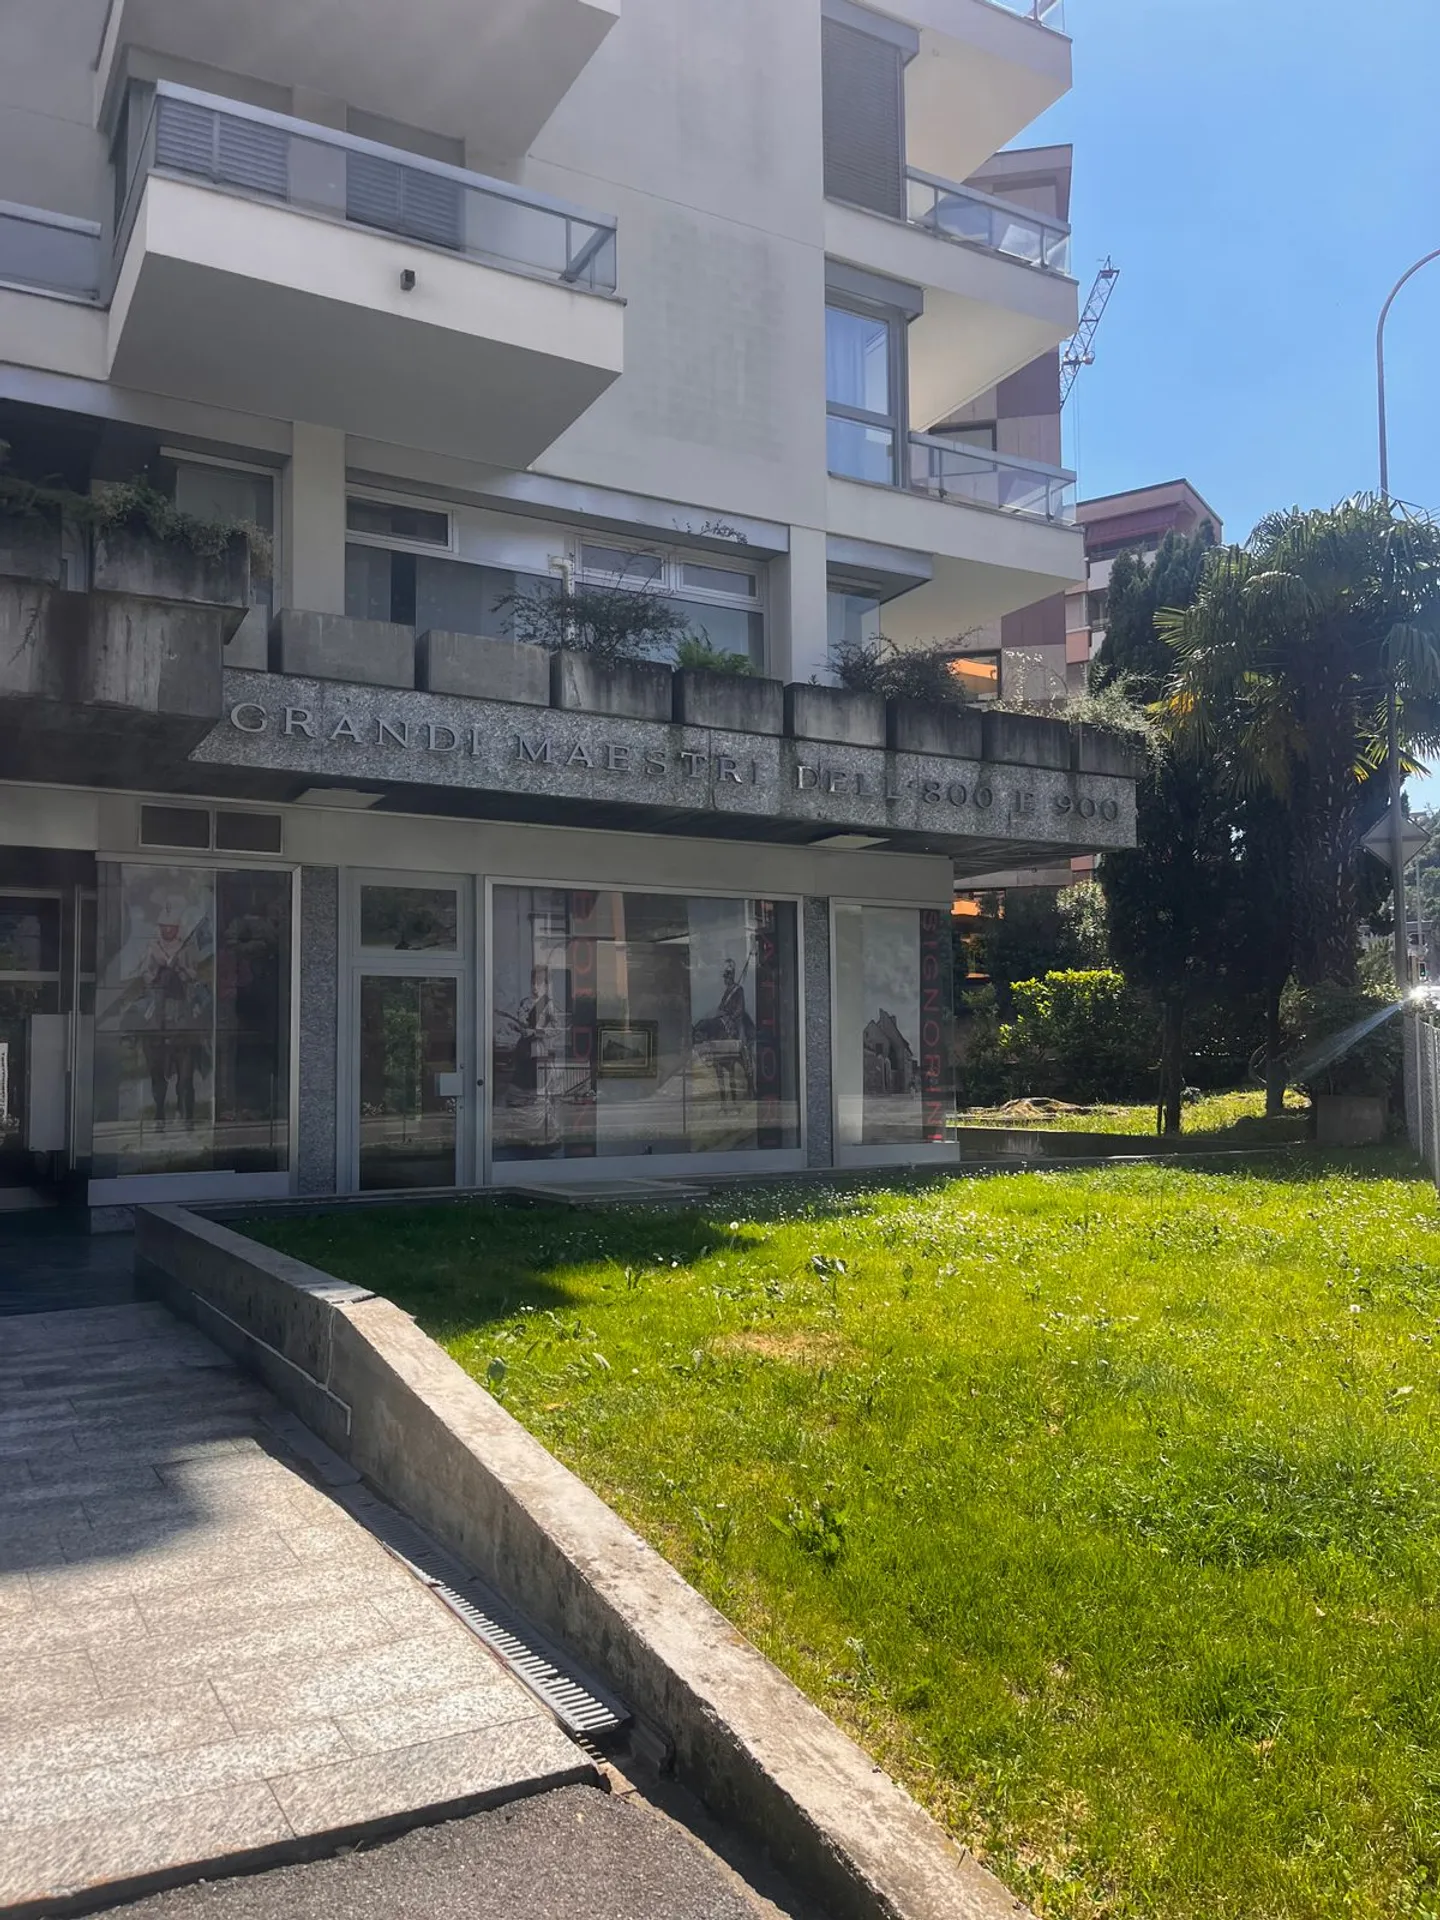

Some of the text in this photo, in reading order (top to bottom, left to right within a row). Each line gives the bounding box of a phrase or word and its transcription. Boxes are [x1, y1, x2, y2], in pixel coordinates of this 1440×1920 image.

[230, 702, 486, 757] GRANDI
[515, 732, 761, 786] MAESTRI
[1015, 789, 1036, 814] E
[1054, 797, 1119, 822] 900
[571, 891, 594, 1156] BOLDNI
[759, 901, 778, 1146] ATTORI
[922, 910, 943, 1140] SIGNORINI
